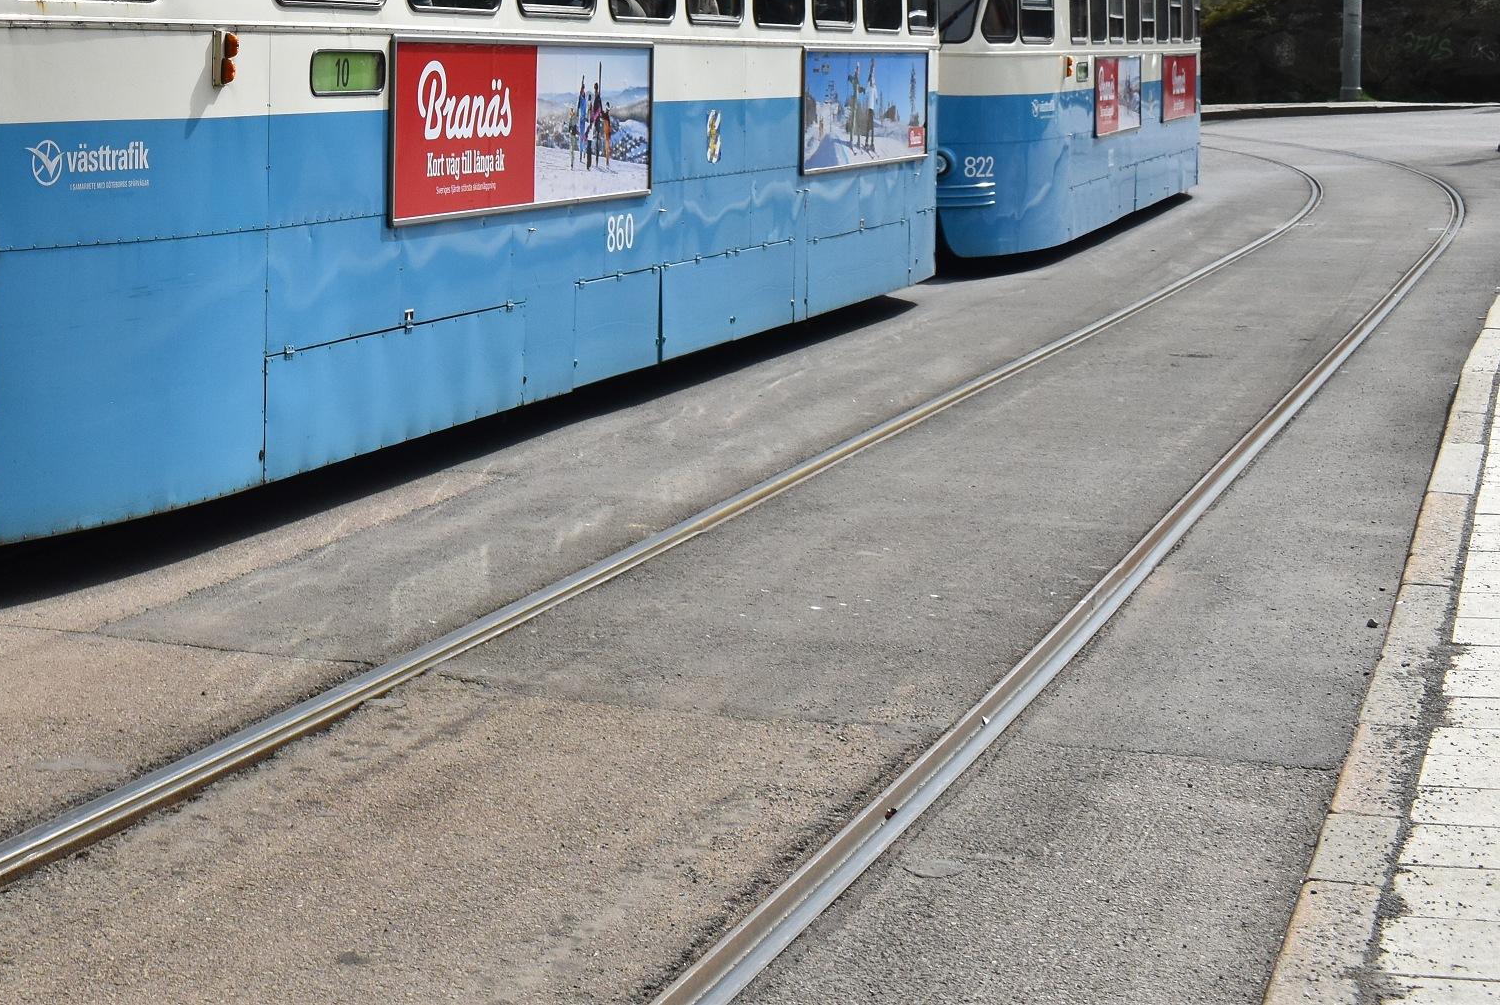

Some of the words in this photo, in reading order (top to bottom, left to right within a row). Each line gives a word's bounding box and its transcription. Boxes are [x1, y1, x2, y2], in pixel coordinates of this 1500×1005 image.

[335, 58, 350, 88] 10
[417, 60, 512, 140] Branäs
[66, 141, 150, 173] västtrafik
[427, 152, 444, 177] Kort
[446, 153, 461, 180] väg
[461, 150, 472, 174] till
[473, 149, 494, 178] långa
[495, 148, 505, 172] åk
[964, 156, 994, 177] 822
[607, 213, 634, 252] 860
